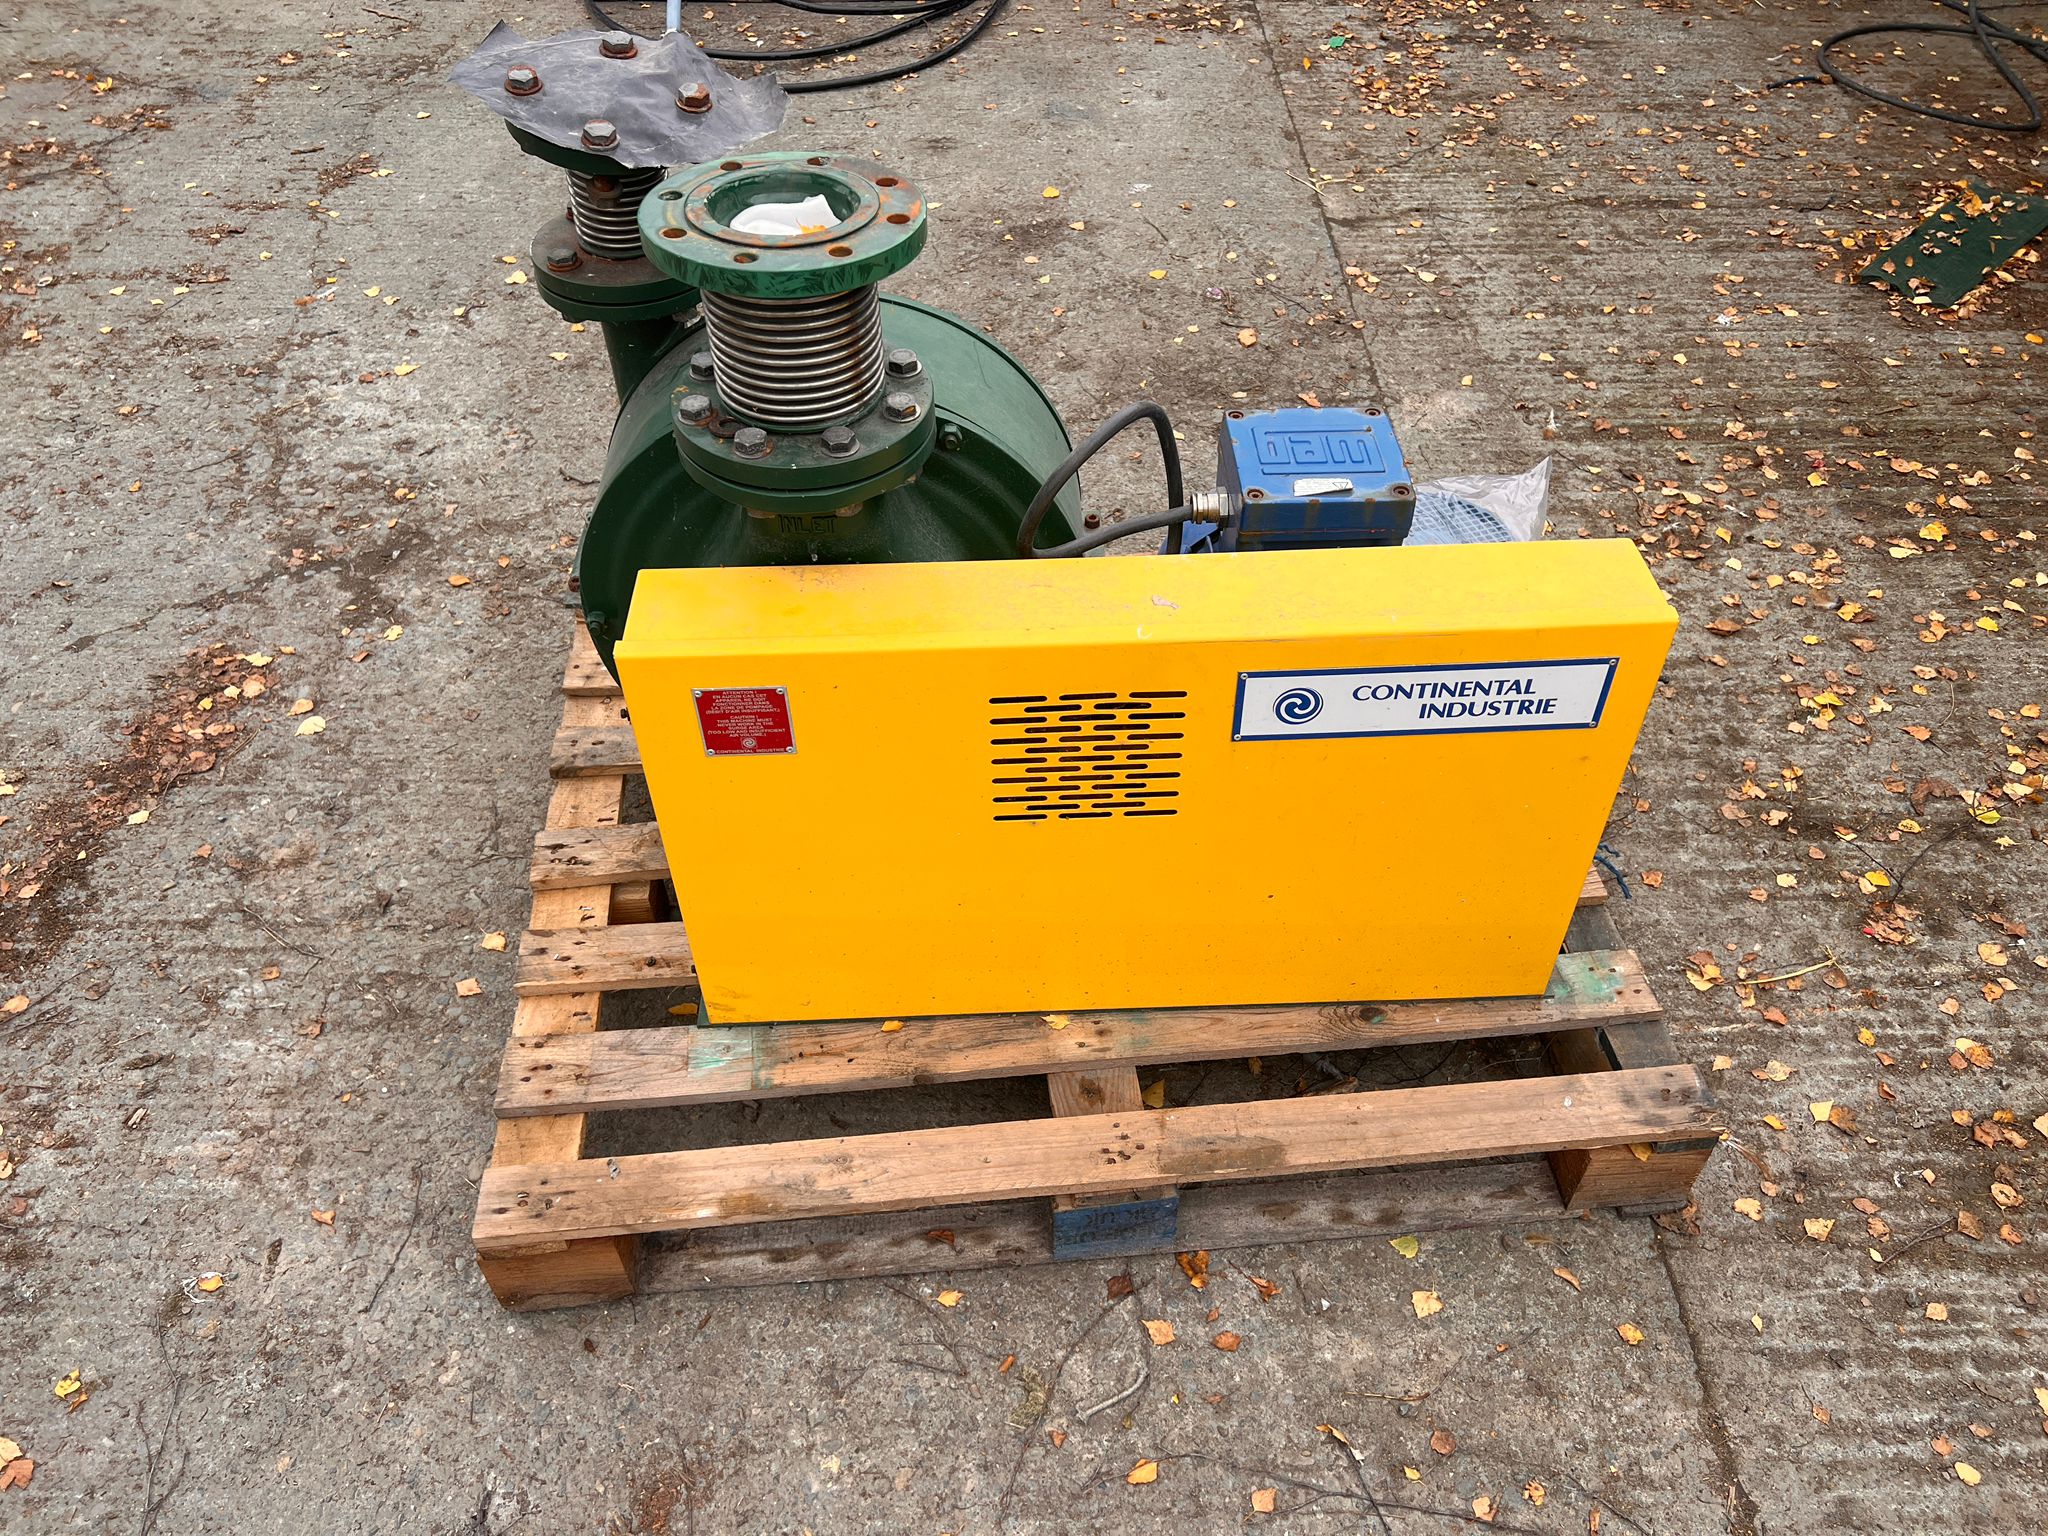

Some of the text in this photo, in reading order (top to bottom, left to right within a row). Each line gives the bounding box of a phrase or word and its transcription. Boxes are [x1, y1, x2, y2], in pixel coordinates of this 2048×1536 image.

[778, 513, 837, 533] INLET
[1352, 678, 1536, 702] CONTINENTAL
[1418, 698, 1559, 719] INDUSTRIE
